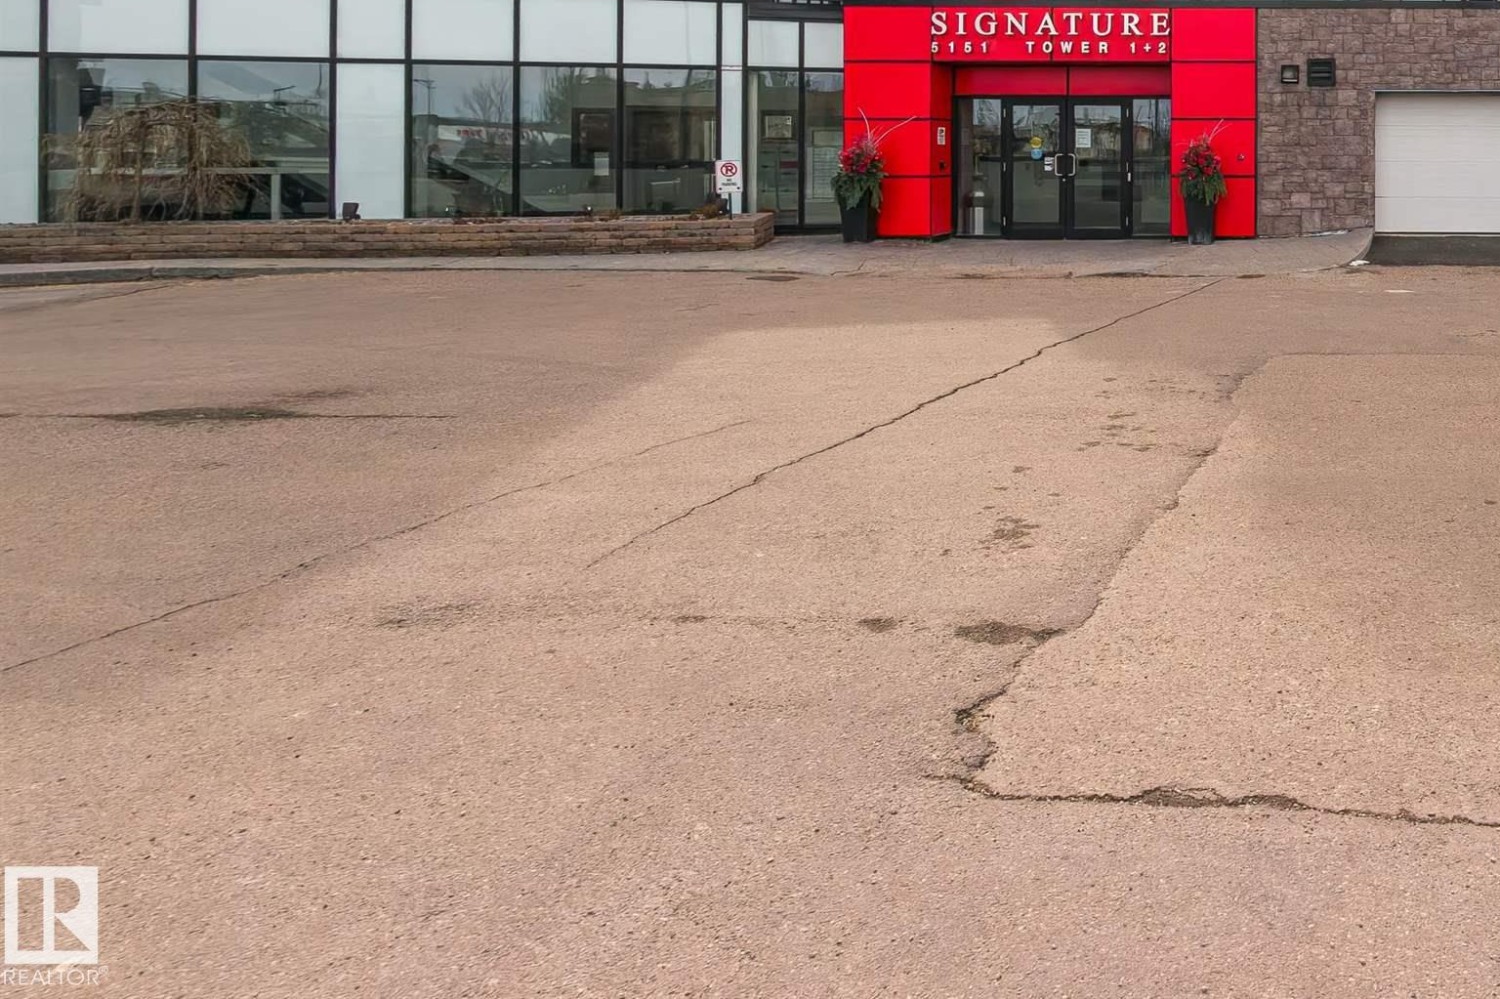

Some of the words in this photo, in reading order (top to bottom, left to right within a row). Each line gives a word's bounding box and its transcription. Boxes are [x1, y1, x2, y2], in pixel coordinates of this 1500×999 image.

[931, 11, 1170, 36] SIGNATURE
[931, 41, 988, 54] 5151
[1026, 41, 1109, 54] TOWER
[1129, 41, 1166, 54] 1+2
